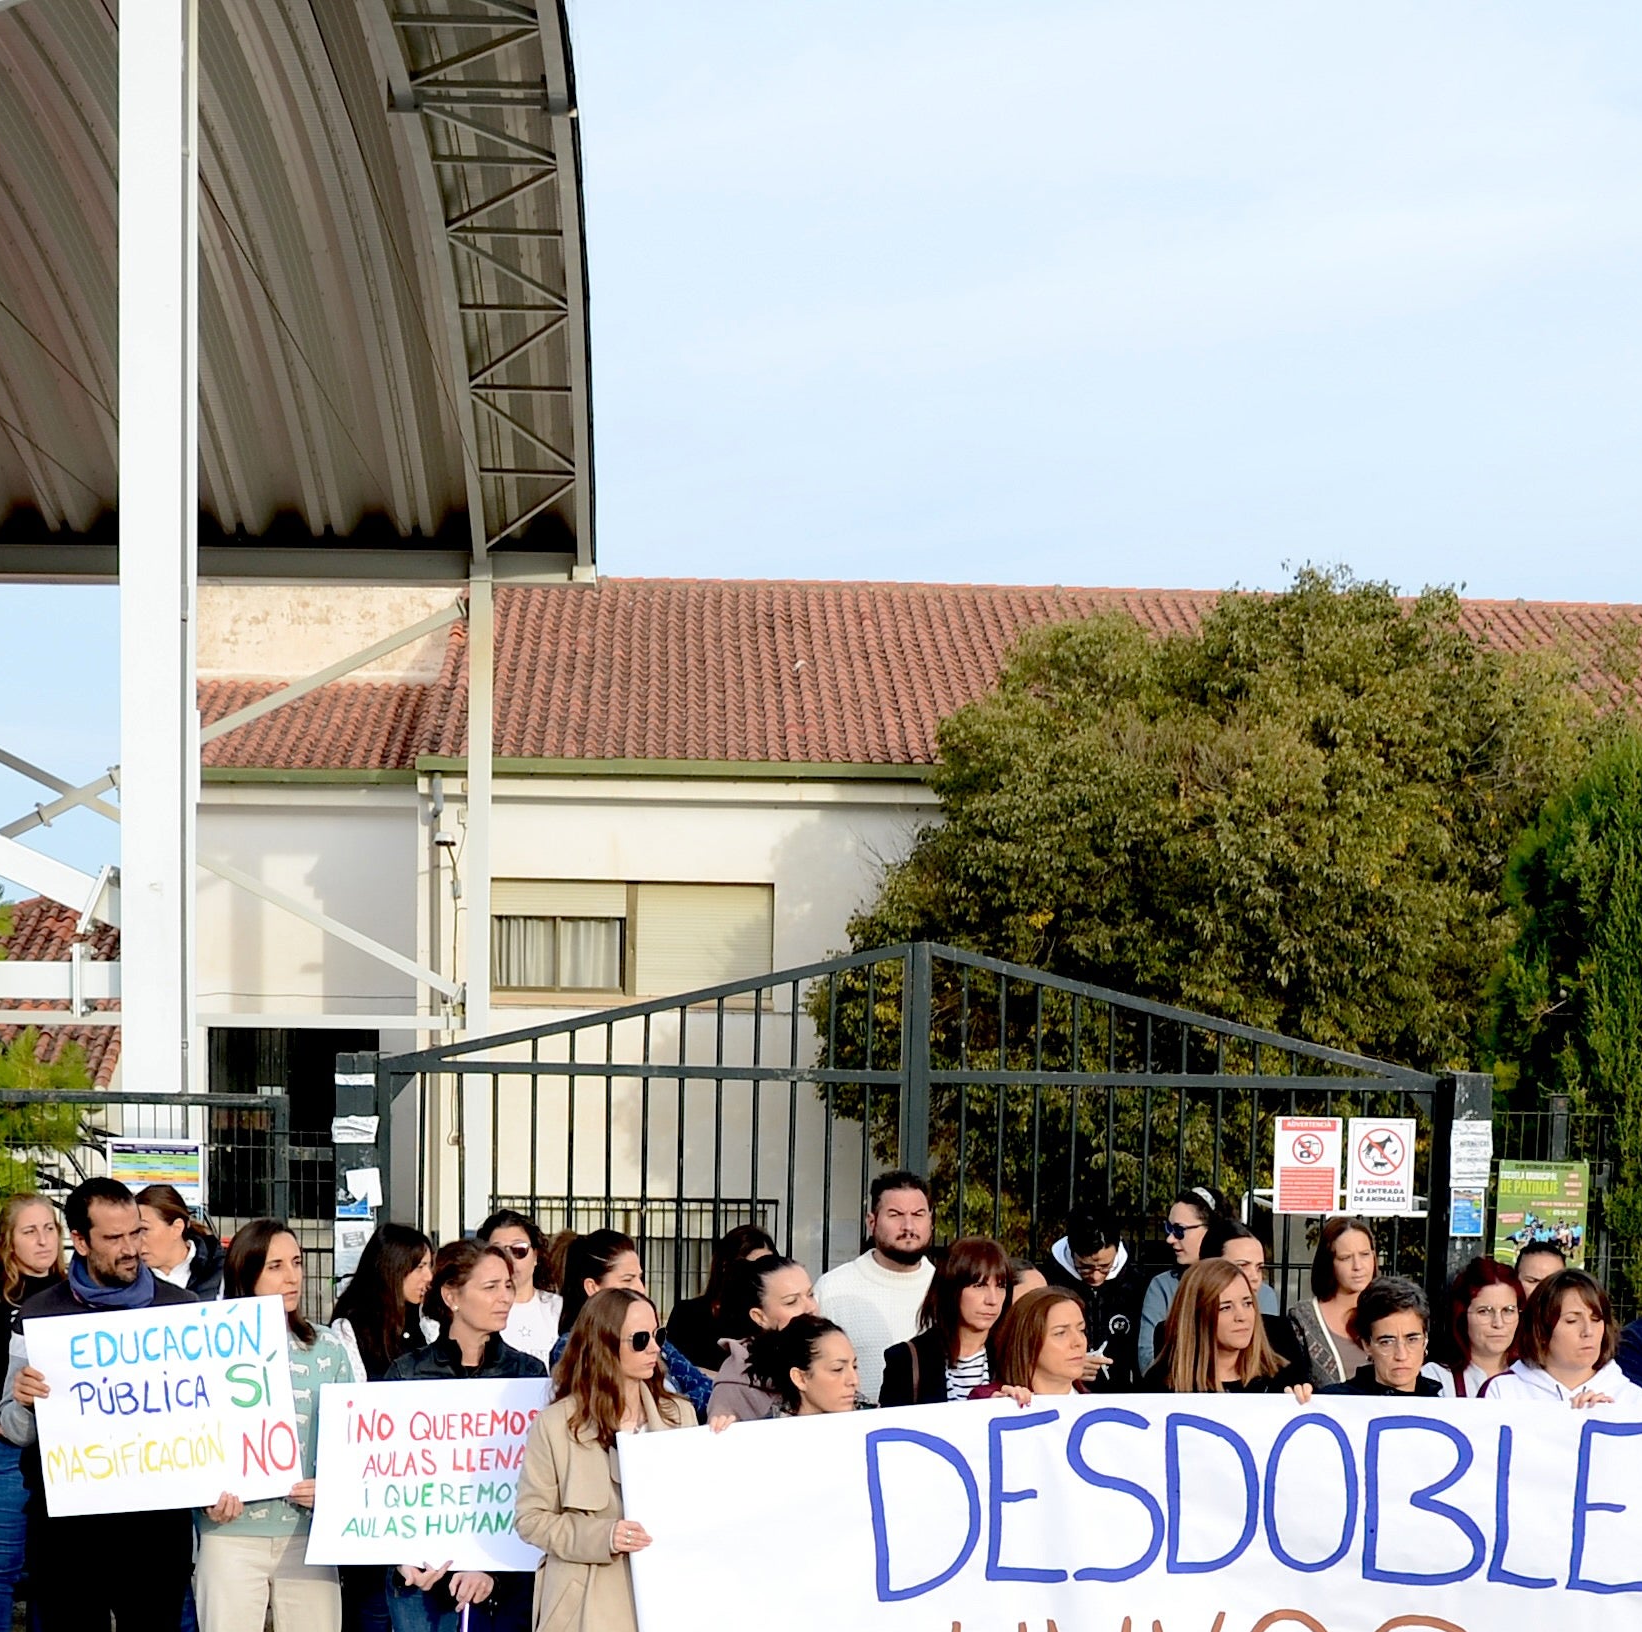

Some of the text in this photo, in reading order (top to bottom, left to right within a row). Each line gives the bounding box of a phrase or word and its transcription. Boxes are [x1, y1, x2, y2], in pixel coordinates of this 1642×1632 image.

[1357, 1179, 1401, 1187] PROHIBIDA
[1367, 1187, 1405, 1195] ENTRADA
[1500, 1179, 1559, 1195] DE PATINAJE
[1366, 1195, 1406, 1204] ANIMALES
[70, 1304, 262, 1370] EDUCACIÓN
[70, 1353, 275, 1416] PÚBLICA SÍ
[242, 1420, 297, 1477] NO
[363, 1449, 437, 1478] AULAS
[341, 1515, 417, 1539] AULAS
